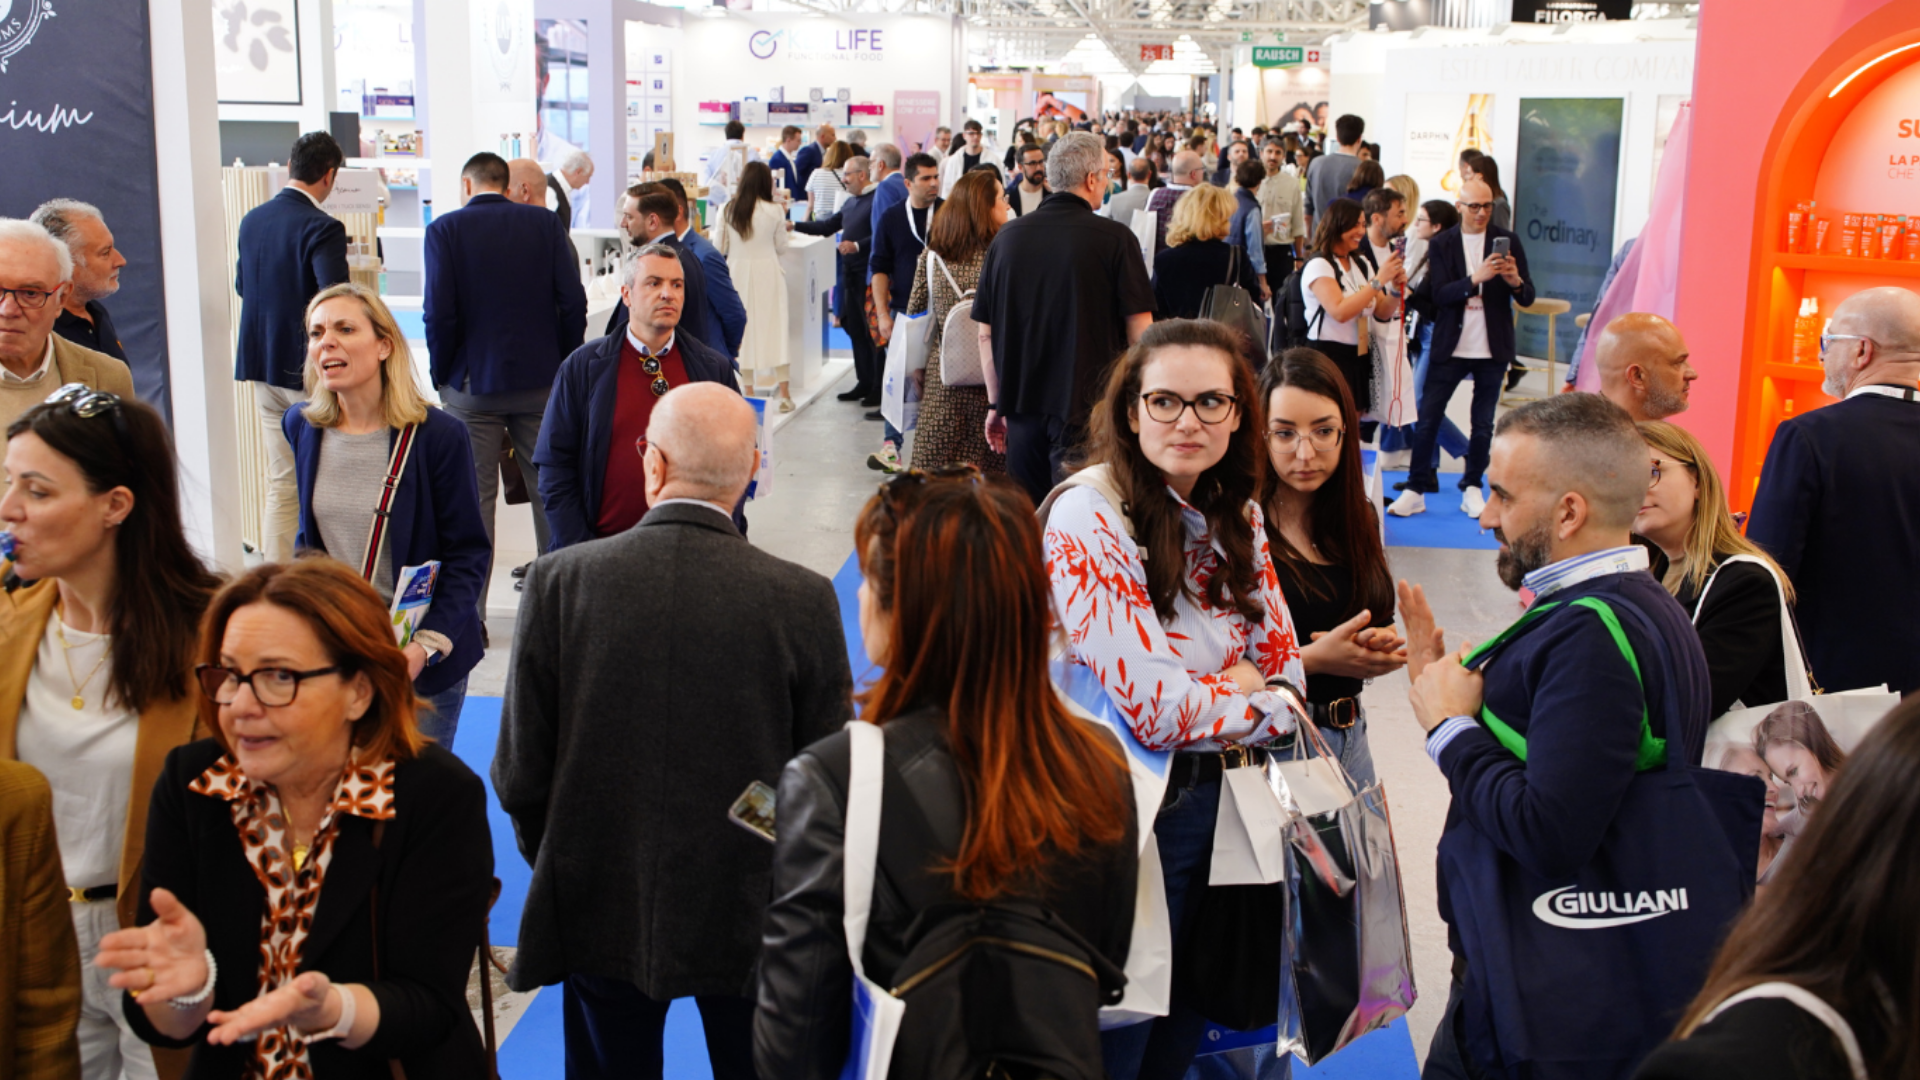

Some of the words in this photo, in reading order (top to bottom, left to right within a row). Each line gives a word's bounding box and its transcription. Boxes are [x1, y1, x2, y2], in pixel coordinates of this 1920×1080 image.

[1534, 10, 1608, 23] FILORGA
[0, 18, 21, 40] MS
[788, 53, 849, 61] FUNCTIONAL
[854, 53, 884, 61] FOOD
[1256, 49, 1300, 60] RAUSCH
[1410, 131, 1450, 141] DARPHIN
[1889, 154, 1907, 166] LA
[1888, 168, 1913, 180] CHE
[1555, 888, 1690, 915] GIULIANI
